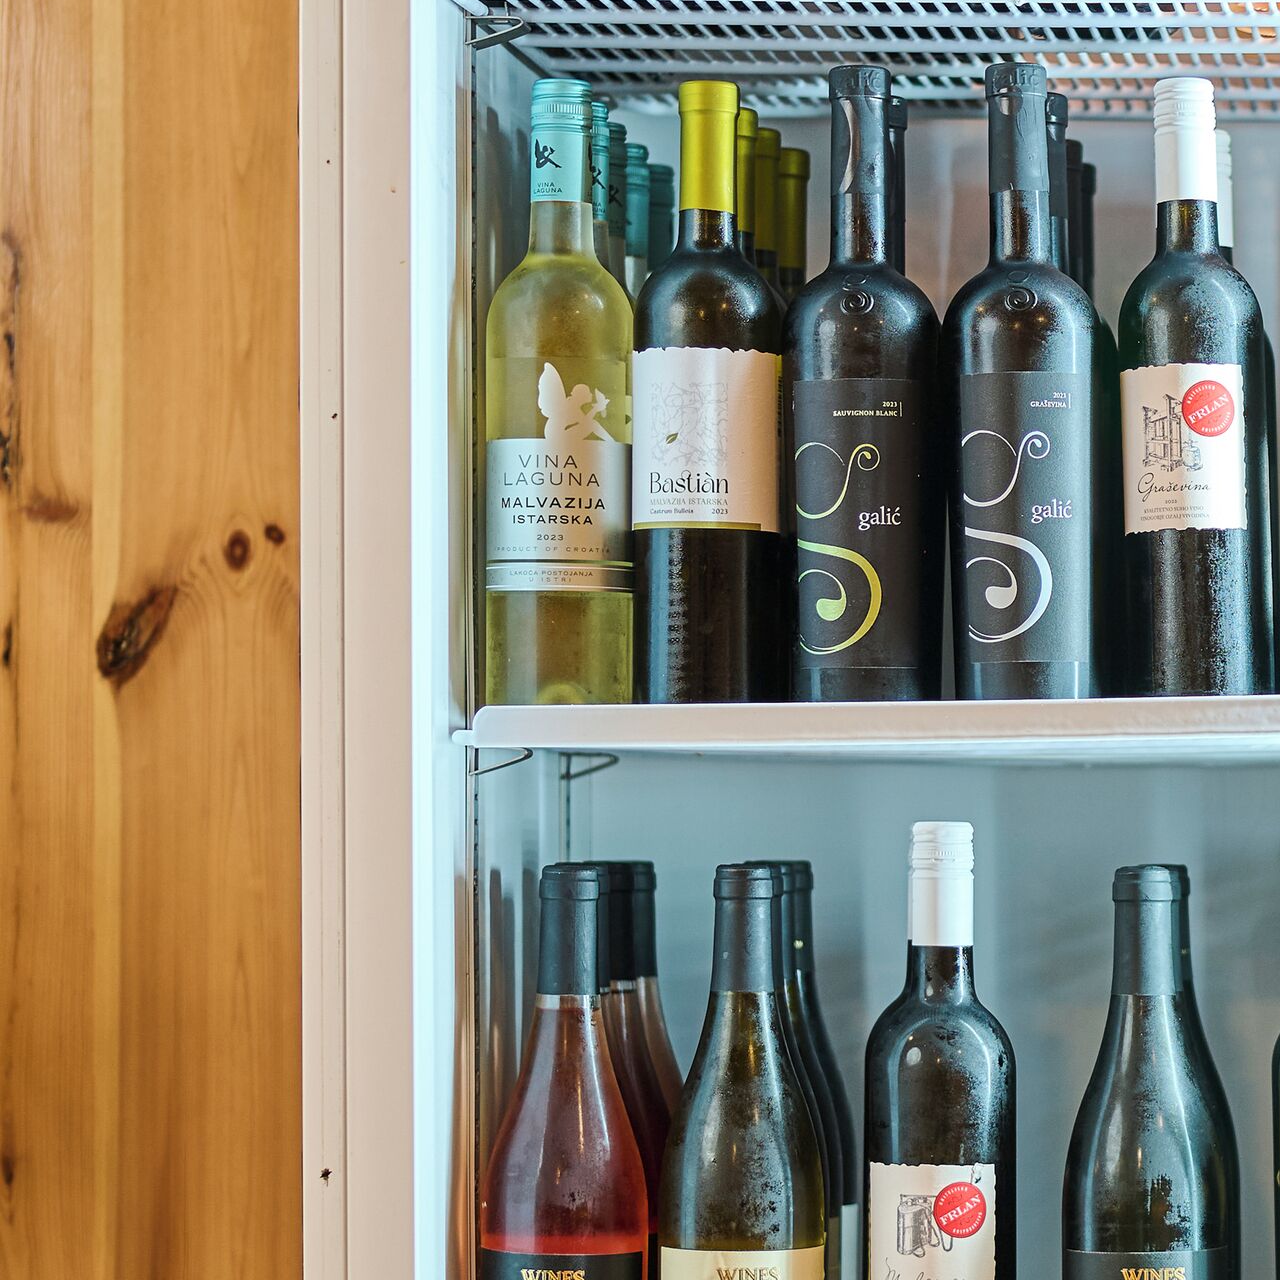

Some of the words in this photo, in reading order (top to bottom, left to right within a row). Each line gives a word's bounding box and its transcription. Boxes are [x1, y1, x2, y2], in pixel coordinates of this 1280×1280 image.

[1188, 393, 1230, 424] FRLAN
[518, 454, 578, 468] VINA
[503, 472, 600, 487] LAGUNA
[650, 469, 729, 493] Bastiàn
[1137, 472, 1211, 502] Graševina
[501, 497, 606, 510] MALVAZIJA
[1030, 499, 1073, 524] galić
[512, 515, 593, 525] ISTARSKA
[858, 505, 902, 531] galić
[939, 1194, 981, 1226] FRLAN
